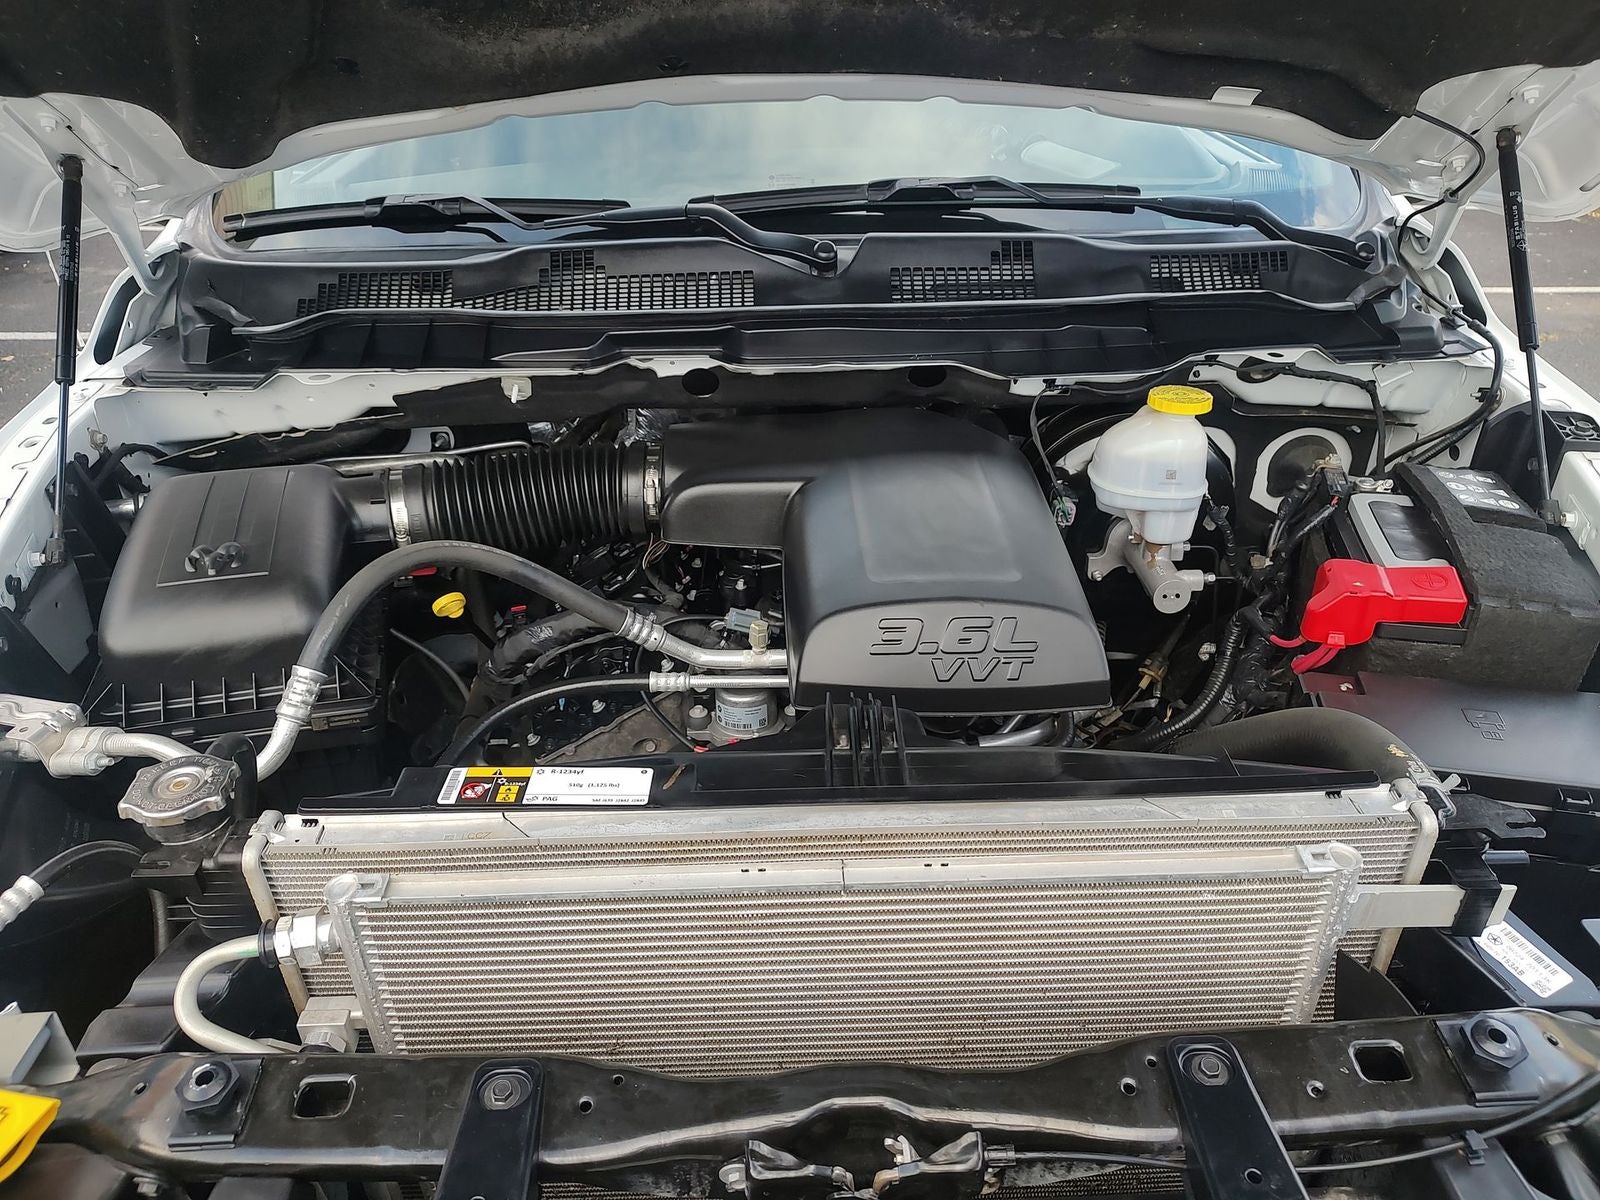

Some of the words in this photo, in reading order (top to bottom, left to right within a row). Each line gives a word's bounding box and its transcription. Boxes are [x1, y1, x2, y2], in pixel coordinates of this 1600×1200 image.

[1512, 205, 1520, 240] STABILUS
[869, 616, 1039, 655] 3.6L
[931, 656, 1034, 682] VVT
